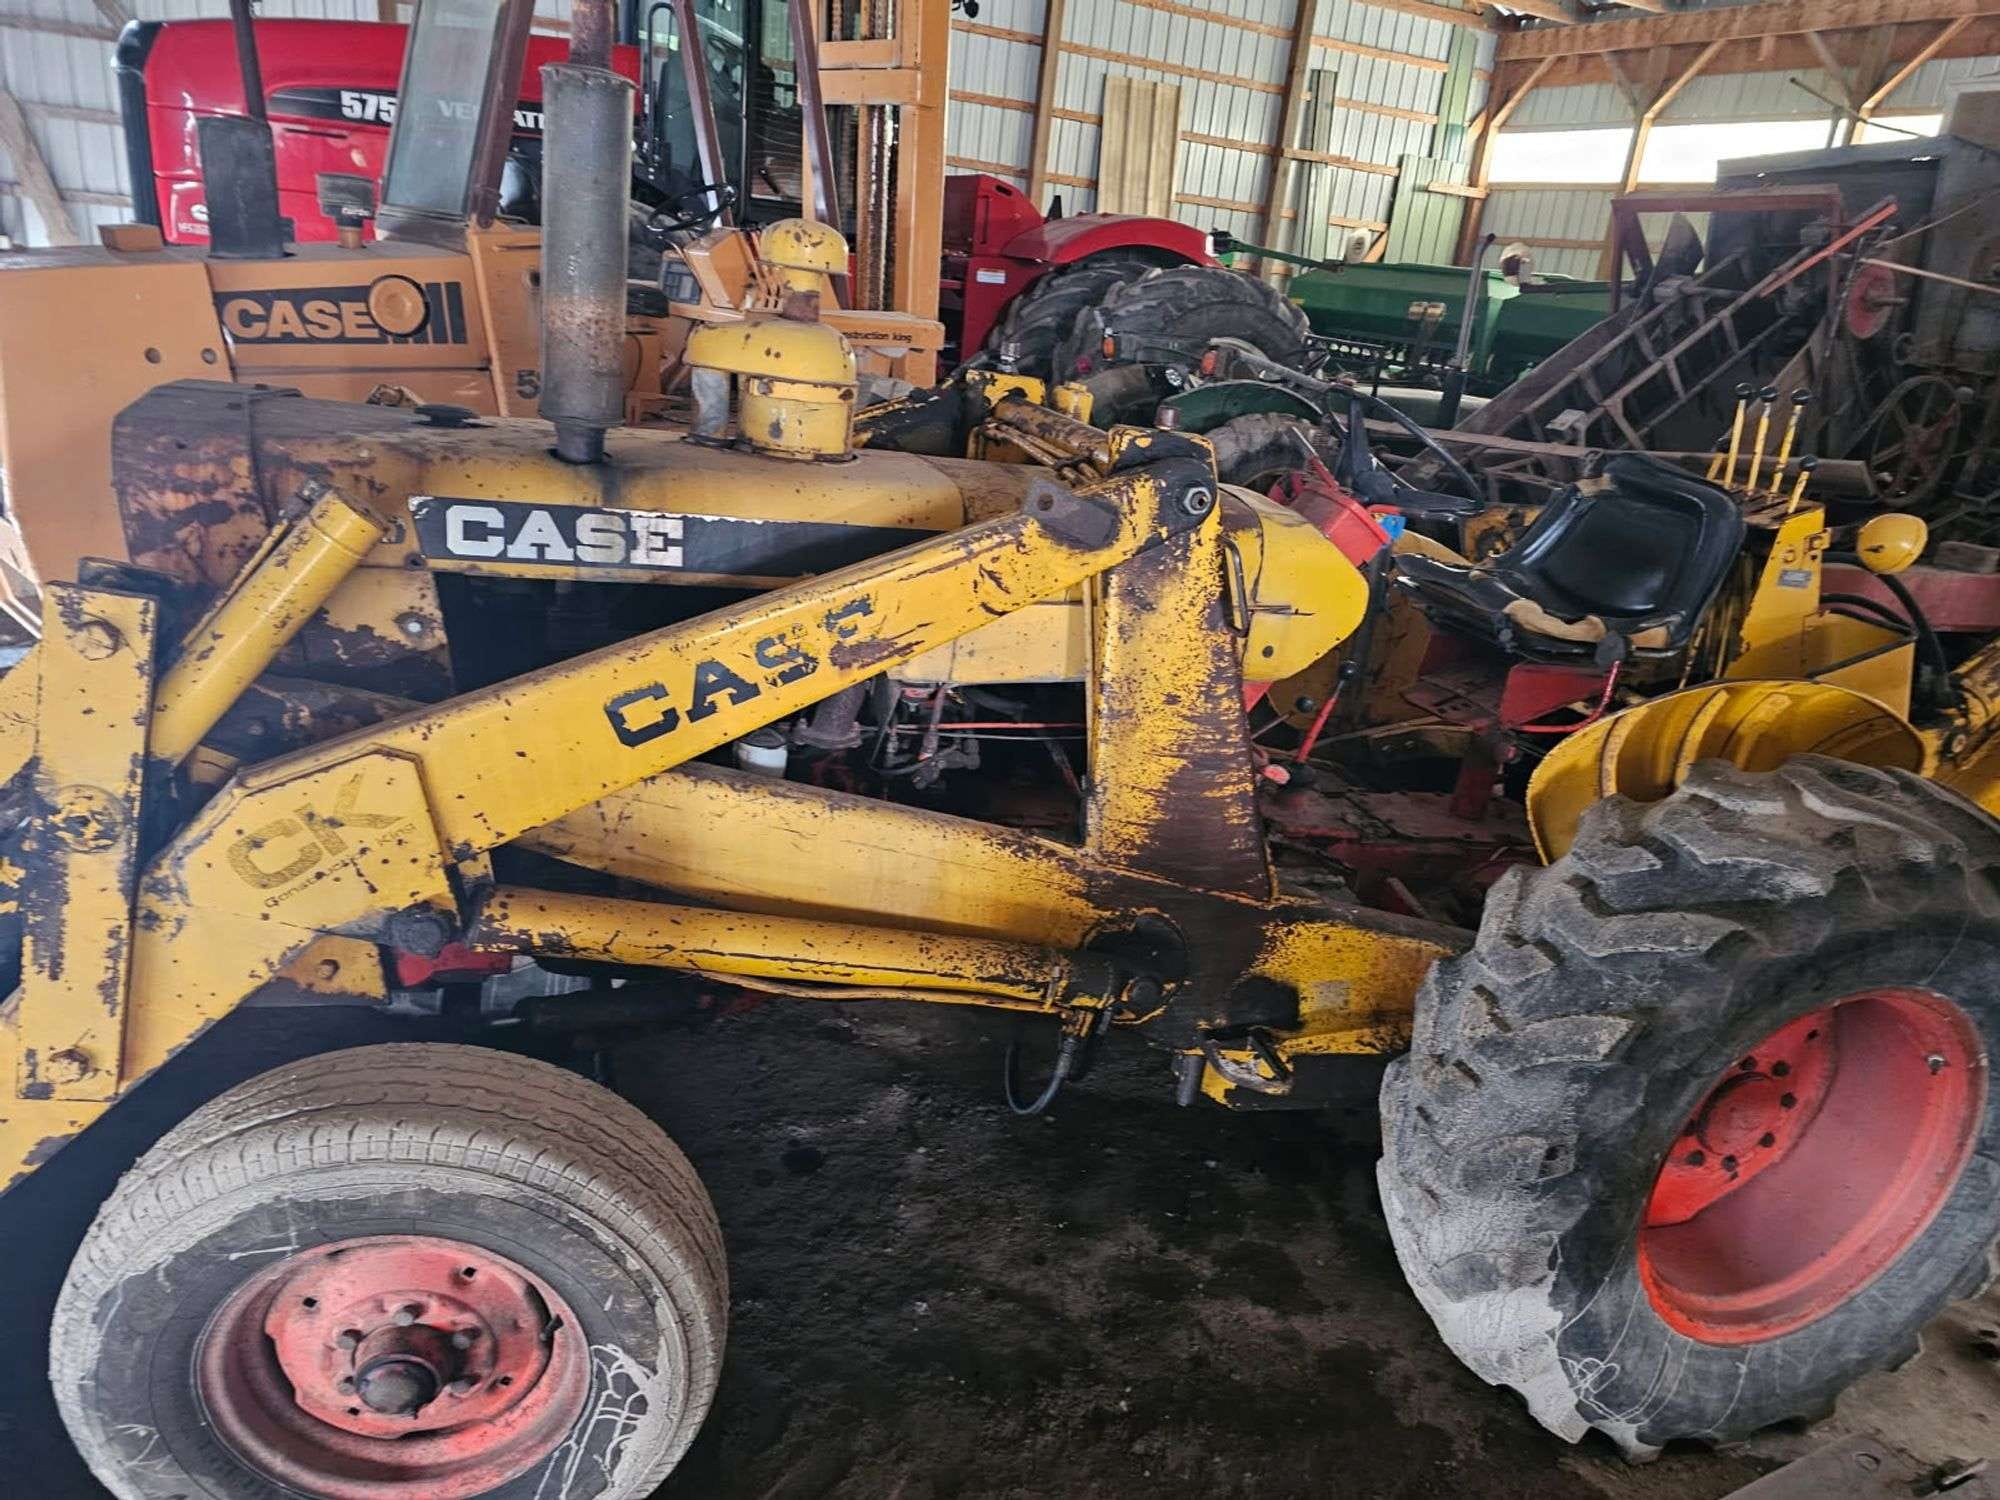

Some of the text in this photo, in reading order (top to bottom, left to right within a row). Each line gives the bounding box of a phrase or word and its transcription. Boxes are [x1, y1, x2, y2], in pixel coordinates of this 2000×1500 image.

[339, 89, 399, 123] 575
[222, 298, 380, 339] CASE
[446, 504, 684, 568] CASE
[603, 593, 875, 748] CASE
[227, 770, 406, 890] CK
